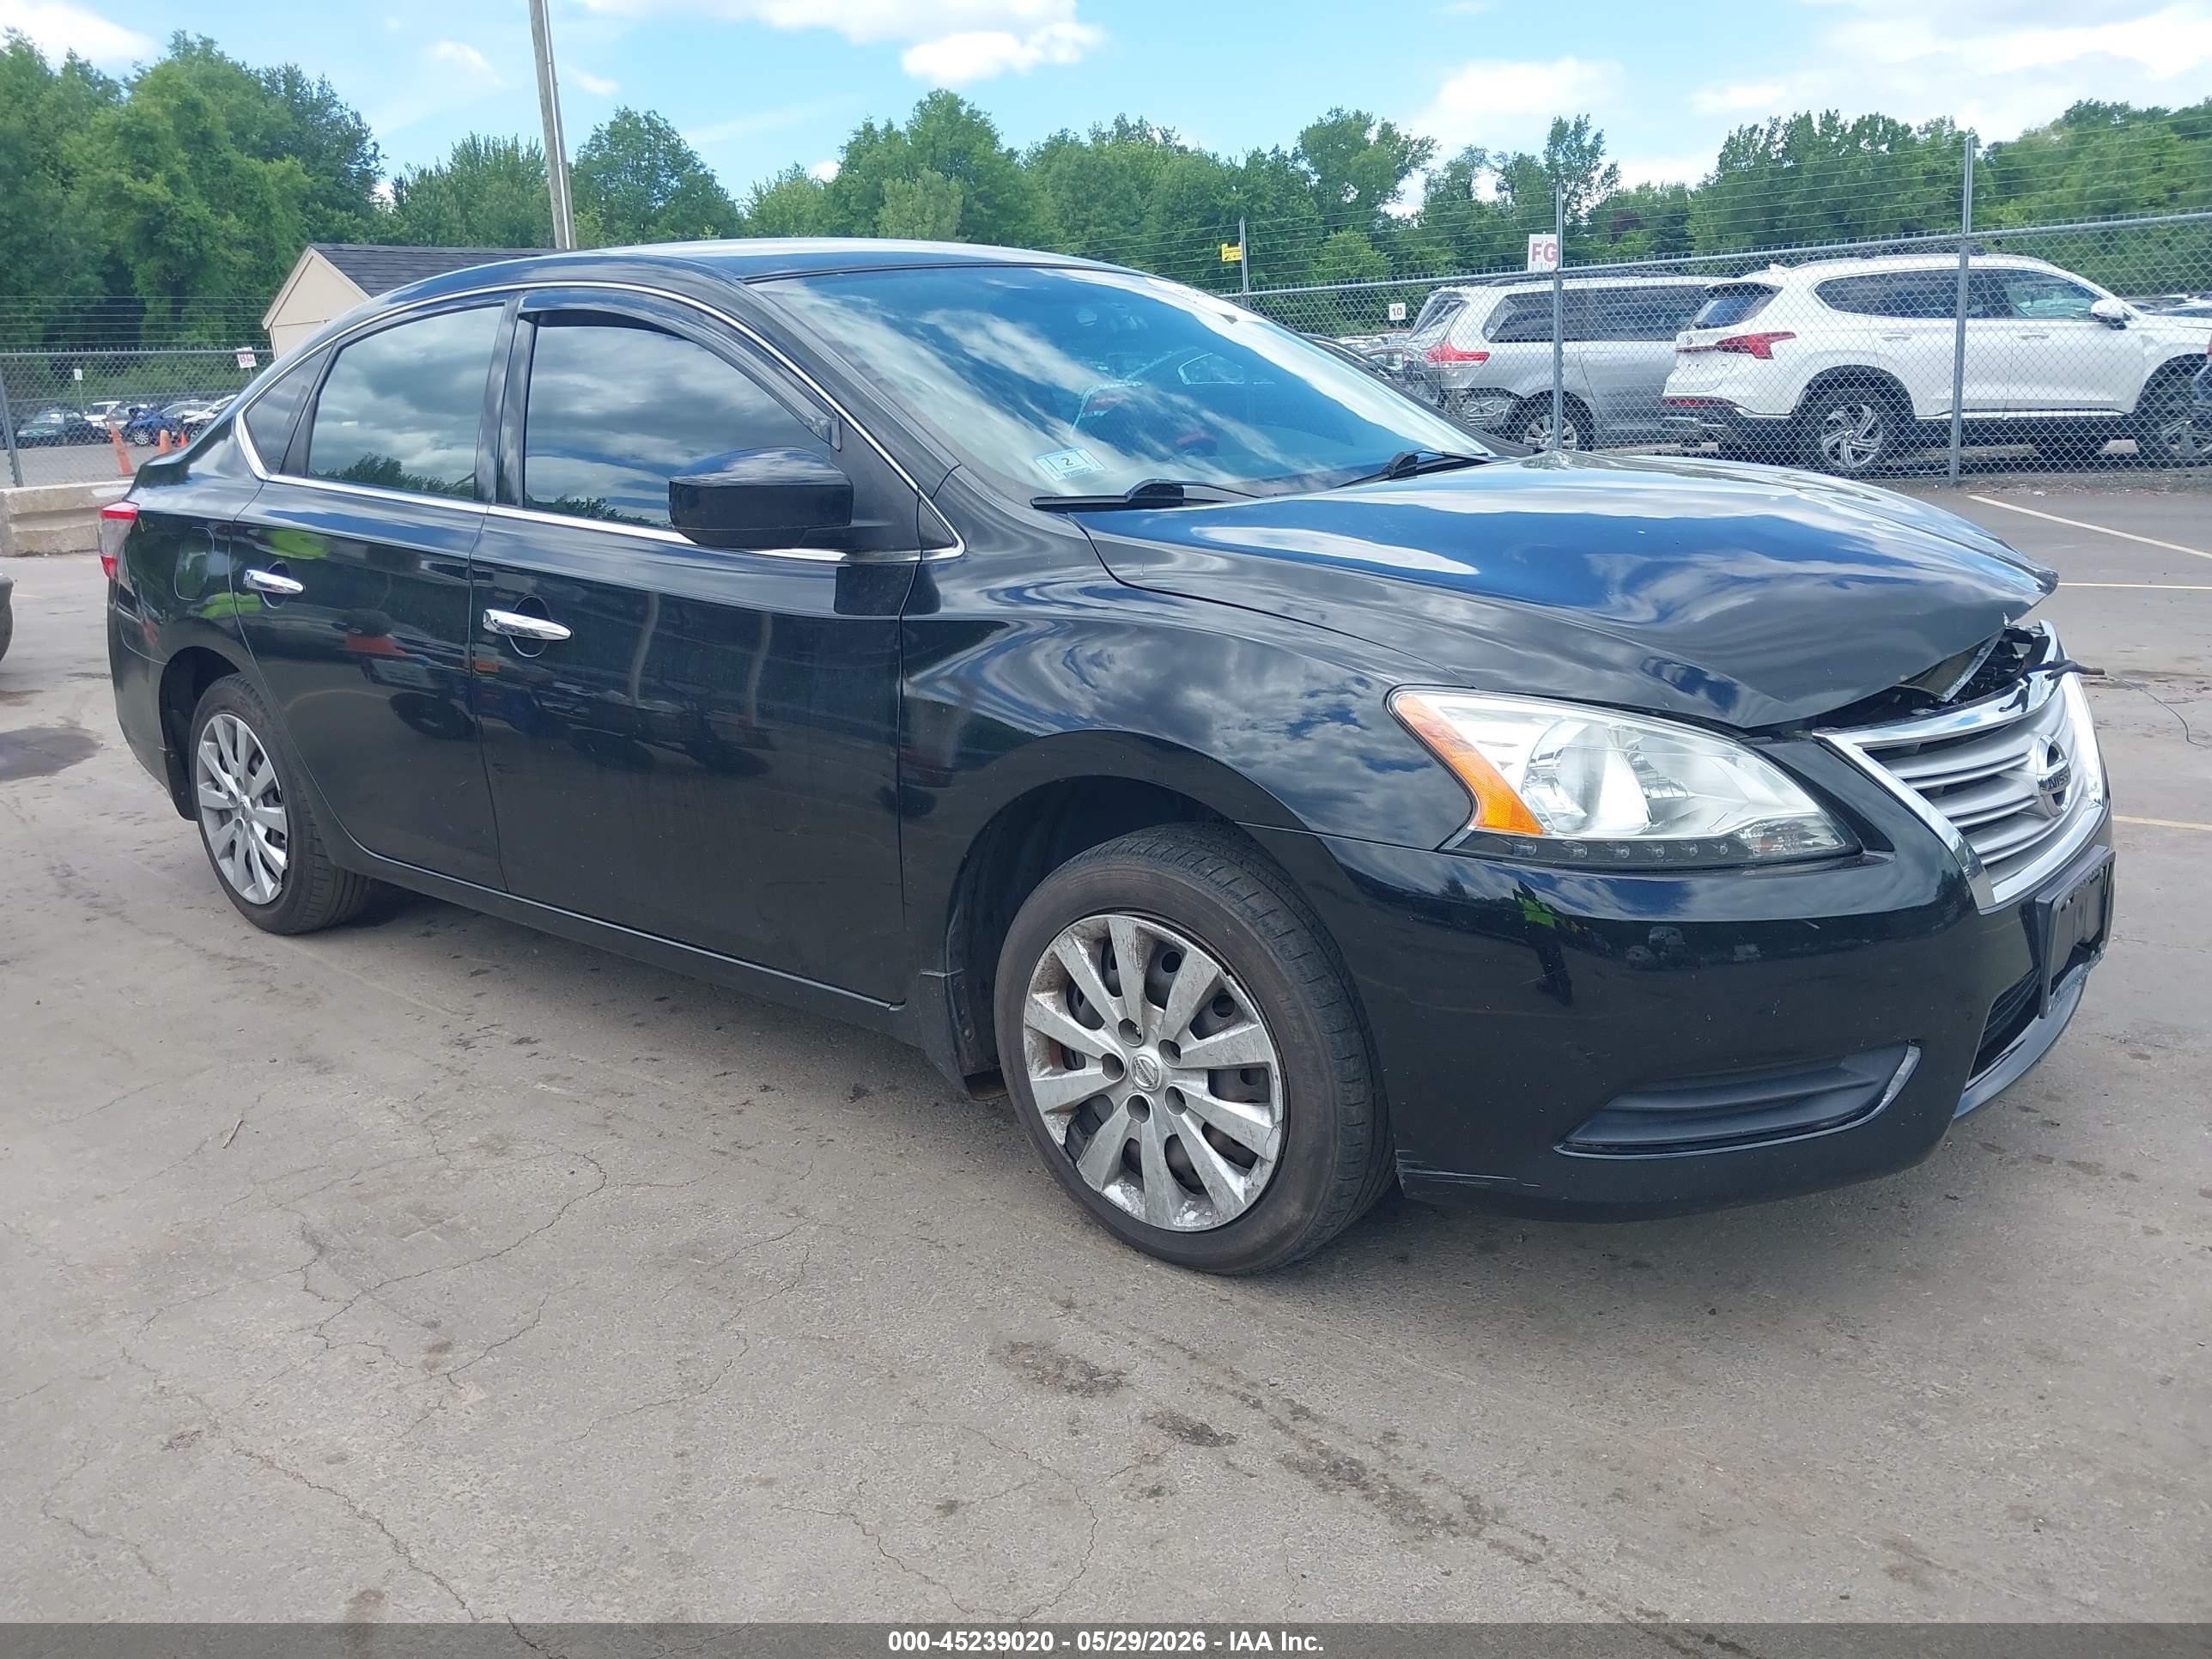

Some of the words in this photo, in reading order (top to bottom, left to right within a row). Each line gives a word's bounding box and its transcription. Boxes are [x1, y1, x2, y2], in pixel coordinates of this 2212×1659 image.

[1531, 242, 1558, 263] FG
[1391, 307, 1403, 317] 10
[1060, 457, 1074, 466] 2
